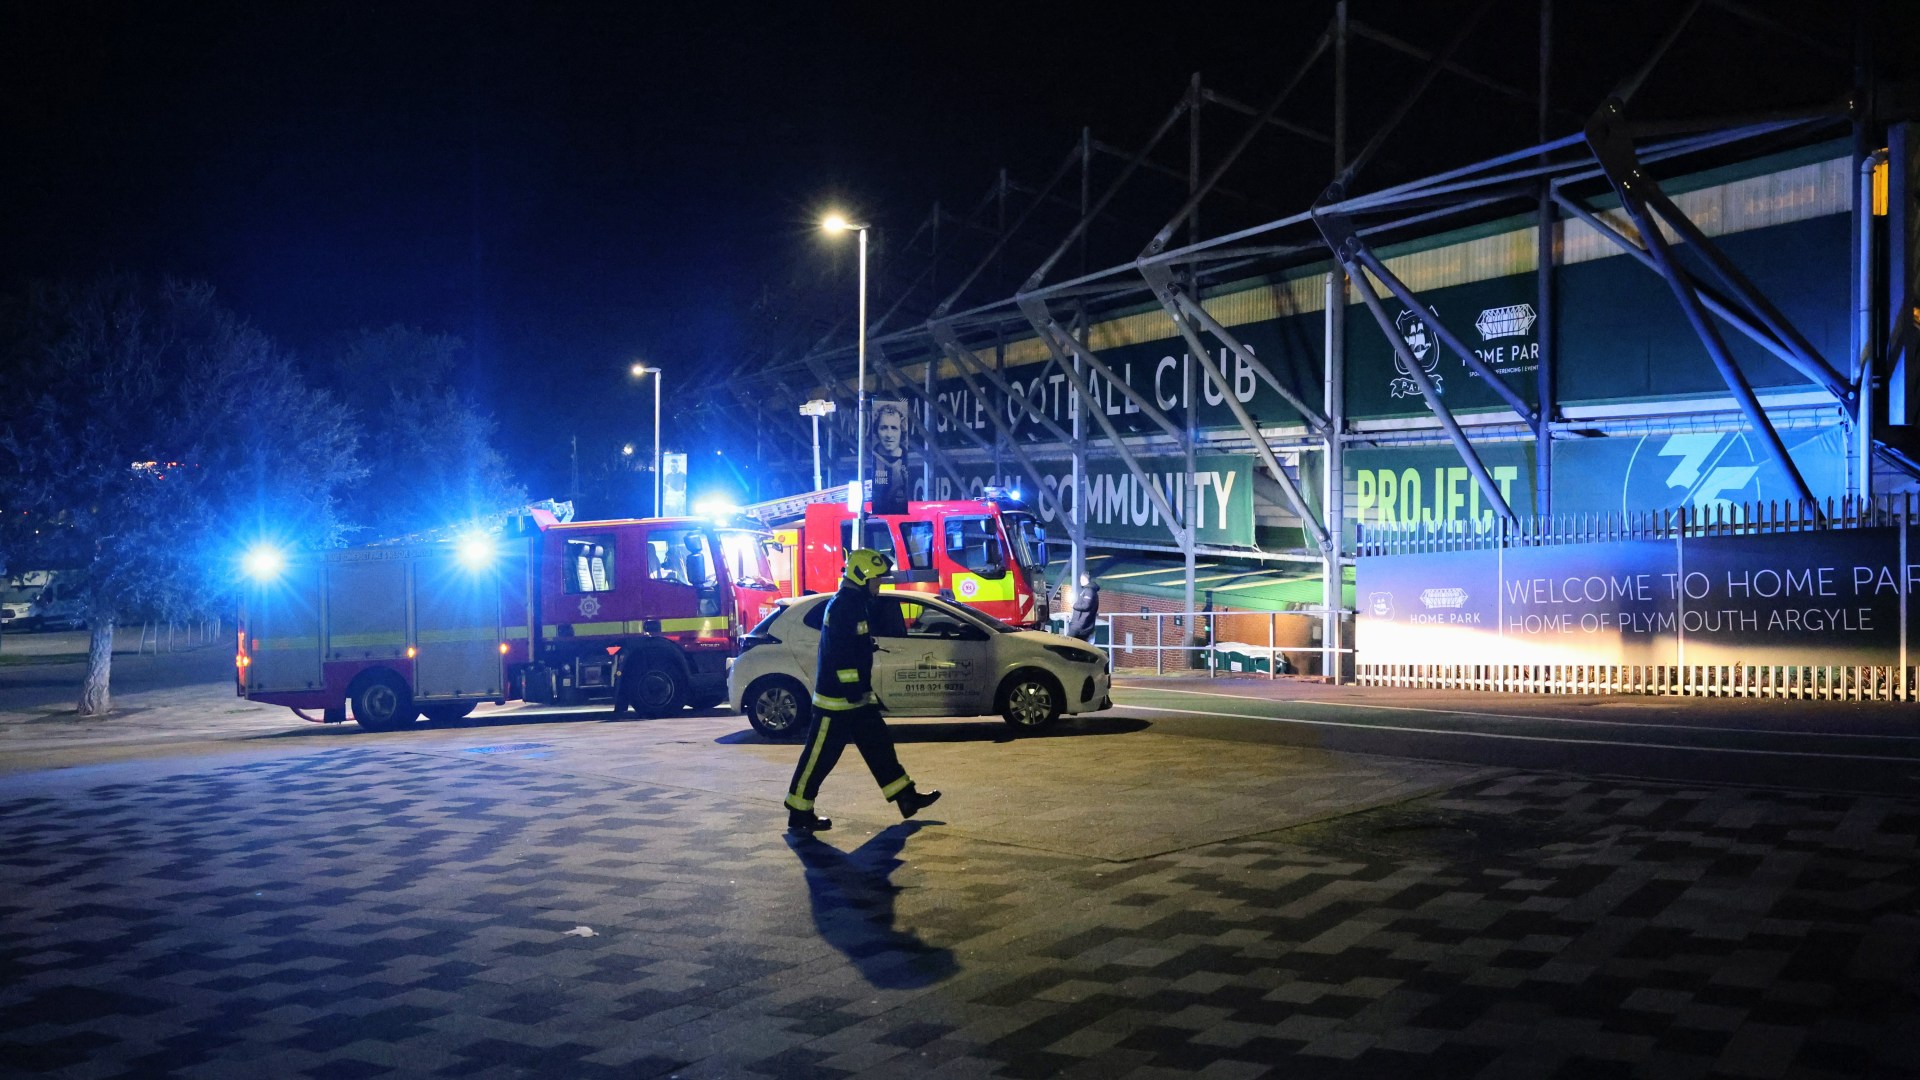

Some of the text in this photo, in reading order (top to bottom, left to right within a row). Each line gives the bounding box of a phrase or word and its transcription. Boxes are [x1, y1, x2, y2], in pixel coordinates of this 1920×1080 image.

[1511, 343, 1539, 361] PAR
[911, 387, 986, 435] AGYLE
[1038, 471, 1236, 529] COMMUNITY
[1357, 466, 1518, 534] PROJECT
[1506, 575, 1652, 604] WELCOME
[1661, 572, 1710, 599] TO
[1727, 567, 1837, 598] HOME
[1410, 612, 1481, 625] HOME PARK
[1509, 608, 1874, 634] HOME OF PLYMOUTH ARGYLE
[897, 670, 971, 679] SECURITY
[905, 684, 925, 692] 0118
